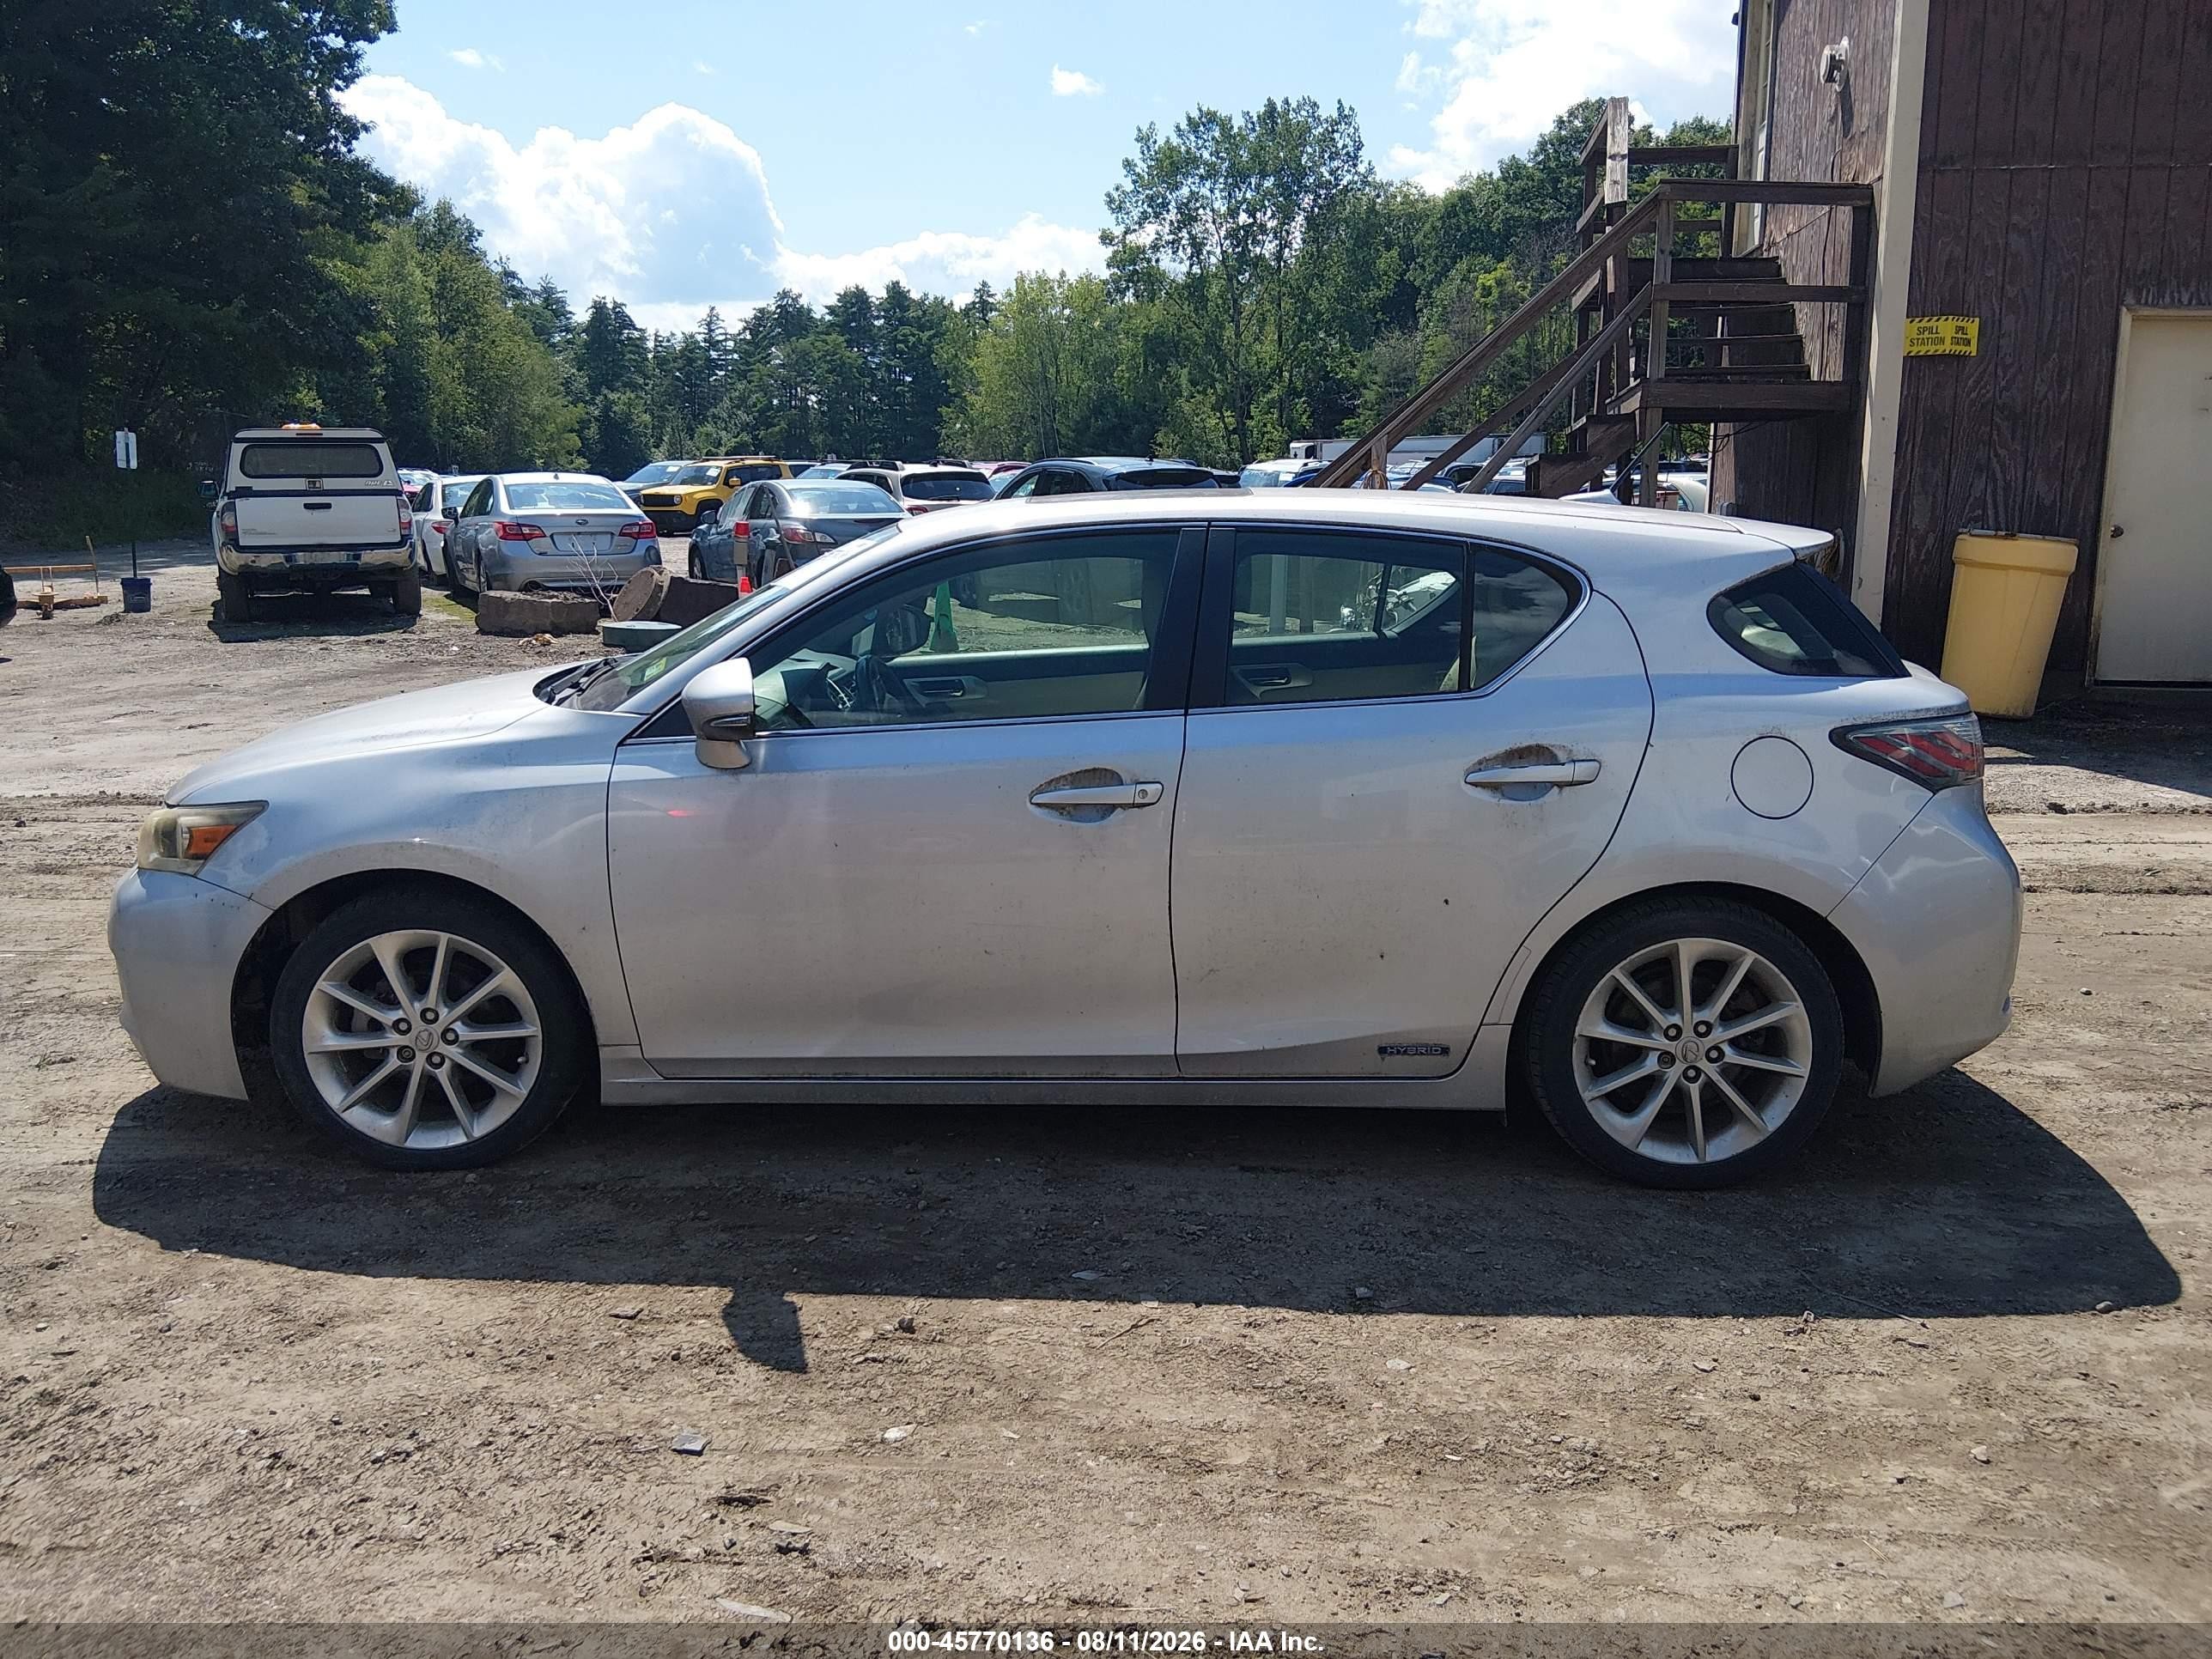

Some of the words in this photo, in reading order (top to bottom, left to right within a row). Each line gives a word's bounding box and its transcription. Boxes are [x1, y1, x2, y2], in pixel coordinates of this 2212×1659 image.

[1916, 325, 1940, 336] SPILL
[1954, 325, 1968, 335] SPILL
[1909, 337, 1945, 347] STATION
[1950, 337, 1971, 347] STATION
